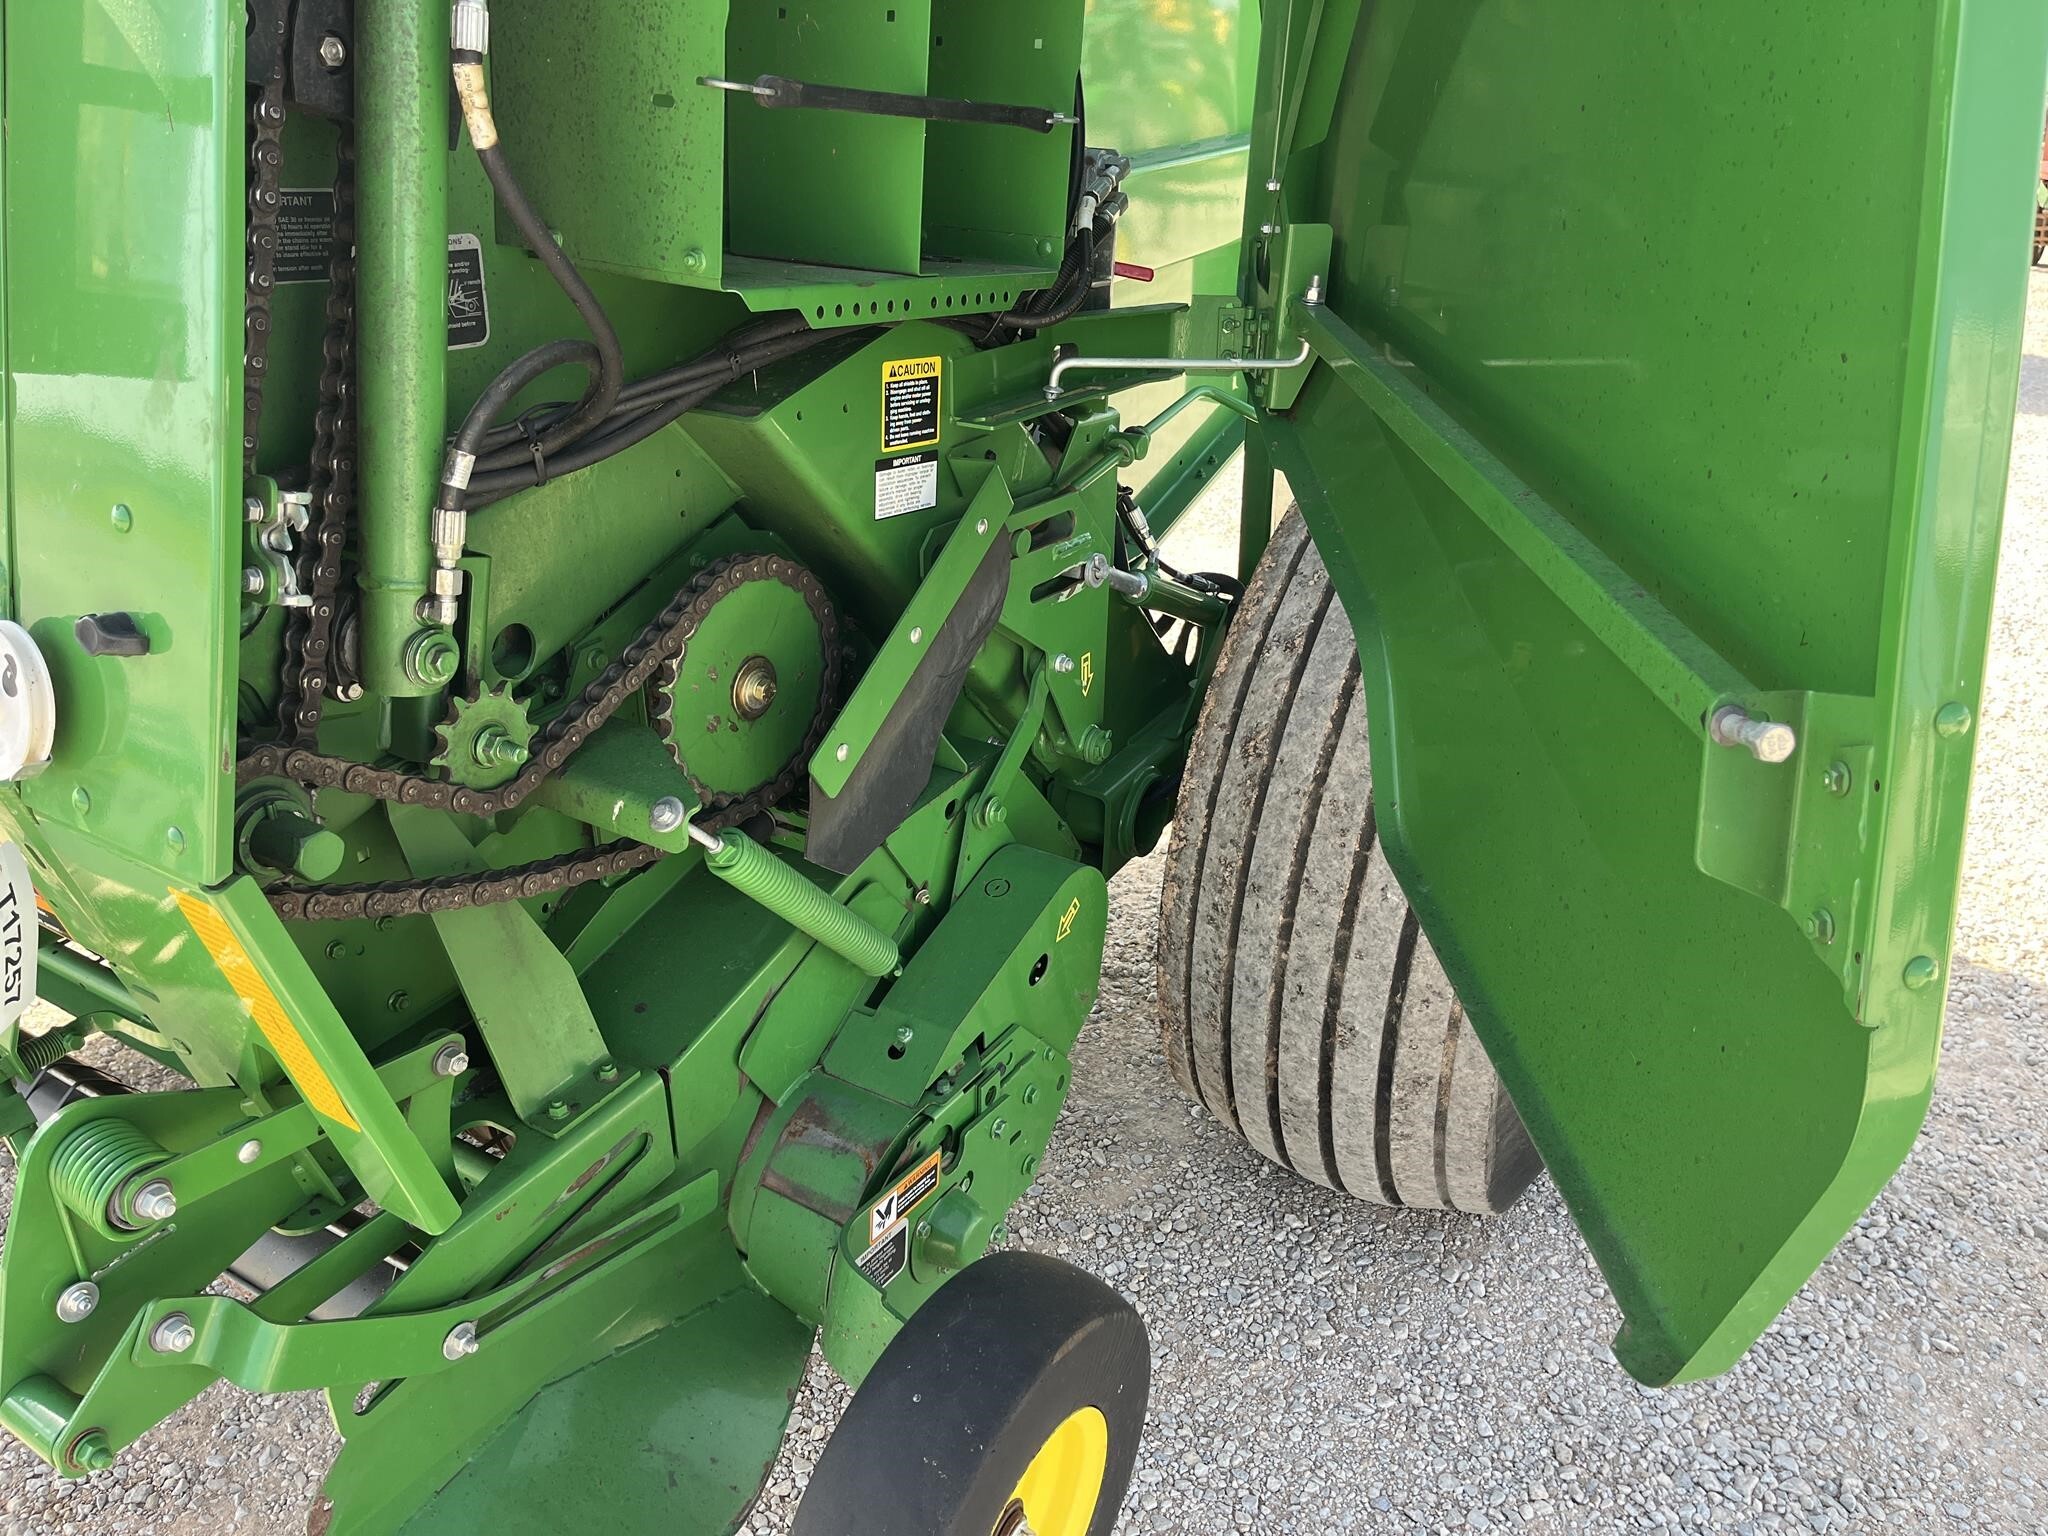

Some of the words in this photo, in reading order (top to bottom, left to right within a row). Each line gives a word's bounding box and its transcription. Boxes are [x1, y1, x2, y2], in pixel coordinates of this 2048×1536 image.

[280, 195, 313, 206] RTANT
[897, 362, 935, 376] CAUTION
[892, 455, 923, 467] IMPORTANT
[0, 882, 23, 1006] T17257
